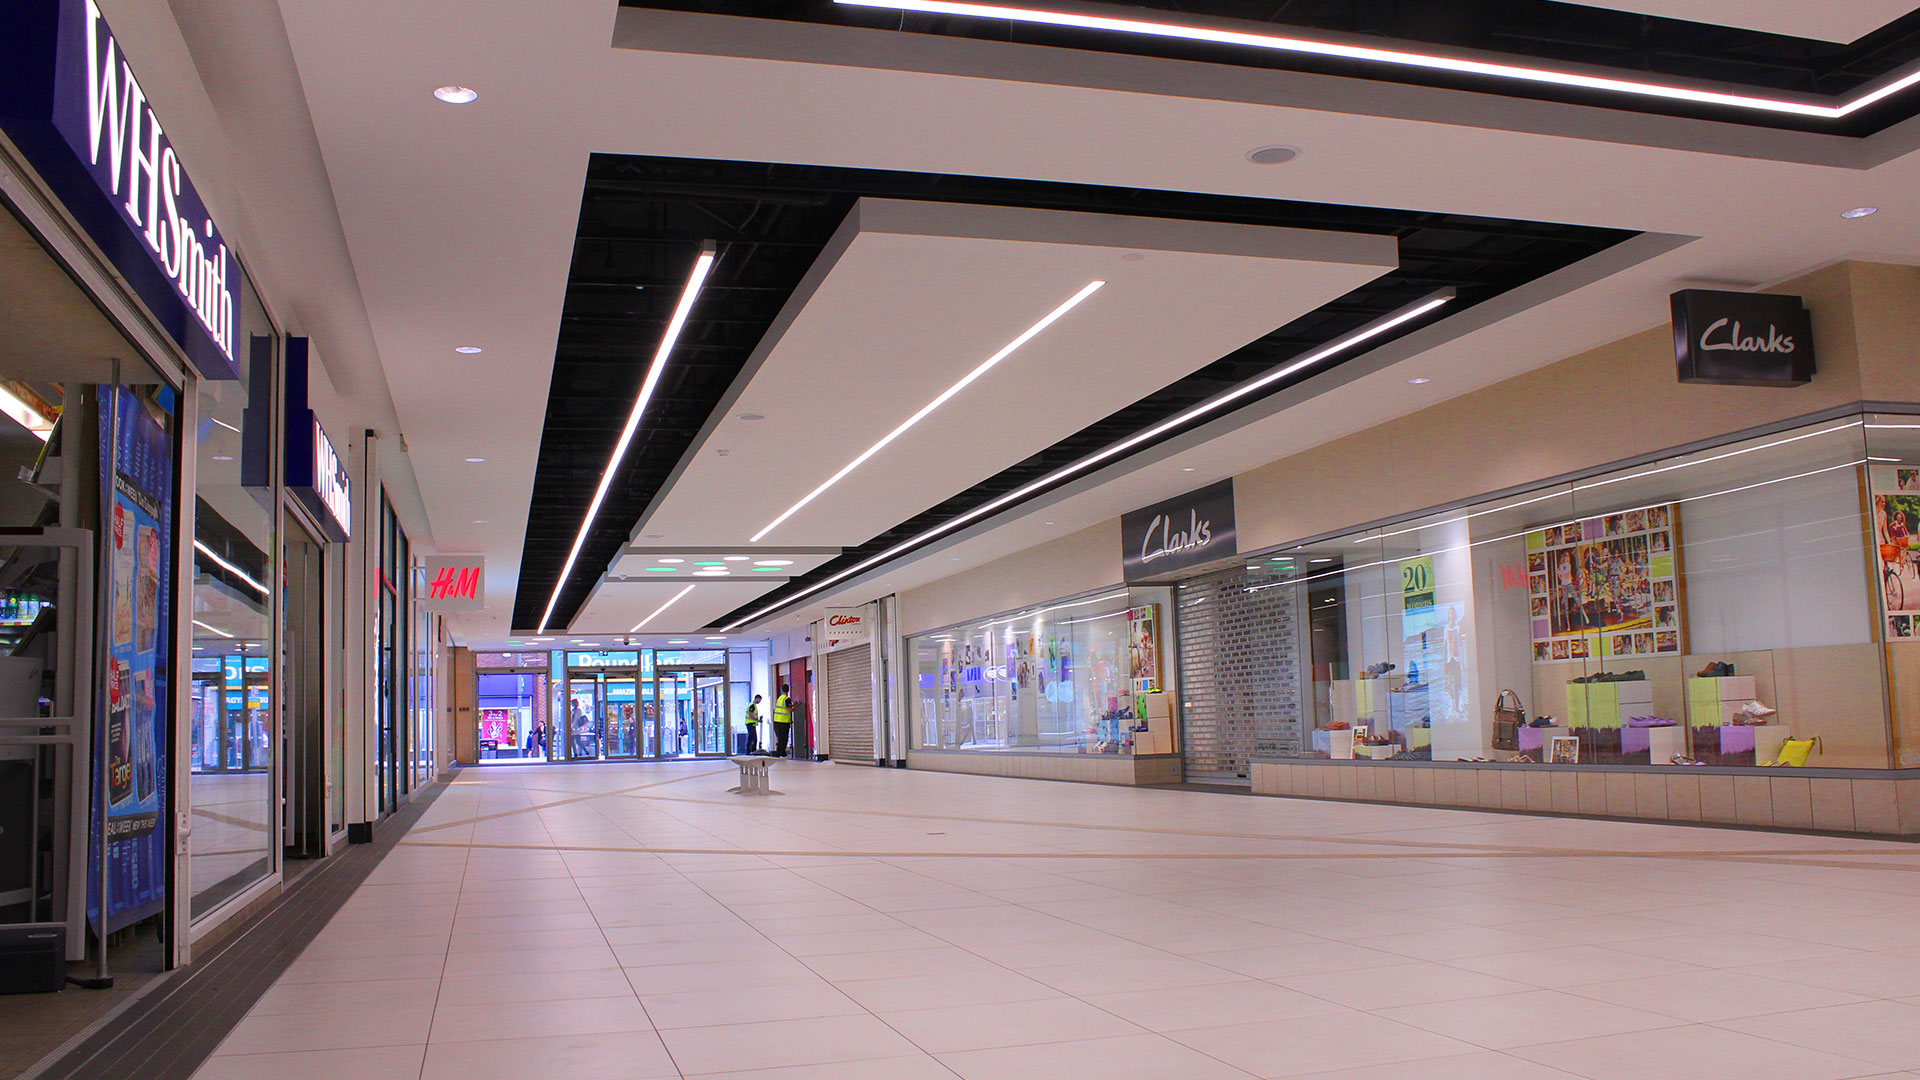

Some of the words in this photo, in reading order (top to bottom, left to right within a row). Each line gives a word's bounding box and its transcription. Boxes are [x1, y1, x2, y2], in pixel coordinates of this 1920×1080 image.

[84, 0, 235, 361] WHSmith
[1699, 317, 1796, 354] Clarks
[315, 421, 351, 537] WHSmith
[1141, 508, 1212, 563] Clarks
[429, 567, 480, 600] H&M
[829, 615, 861, 626] Clinton
[578, 654, 681, 672] Pounlan
